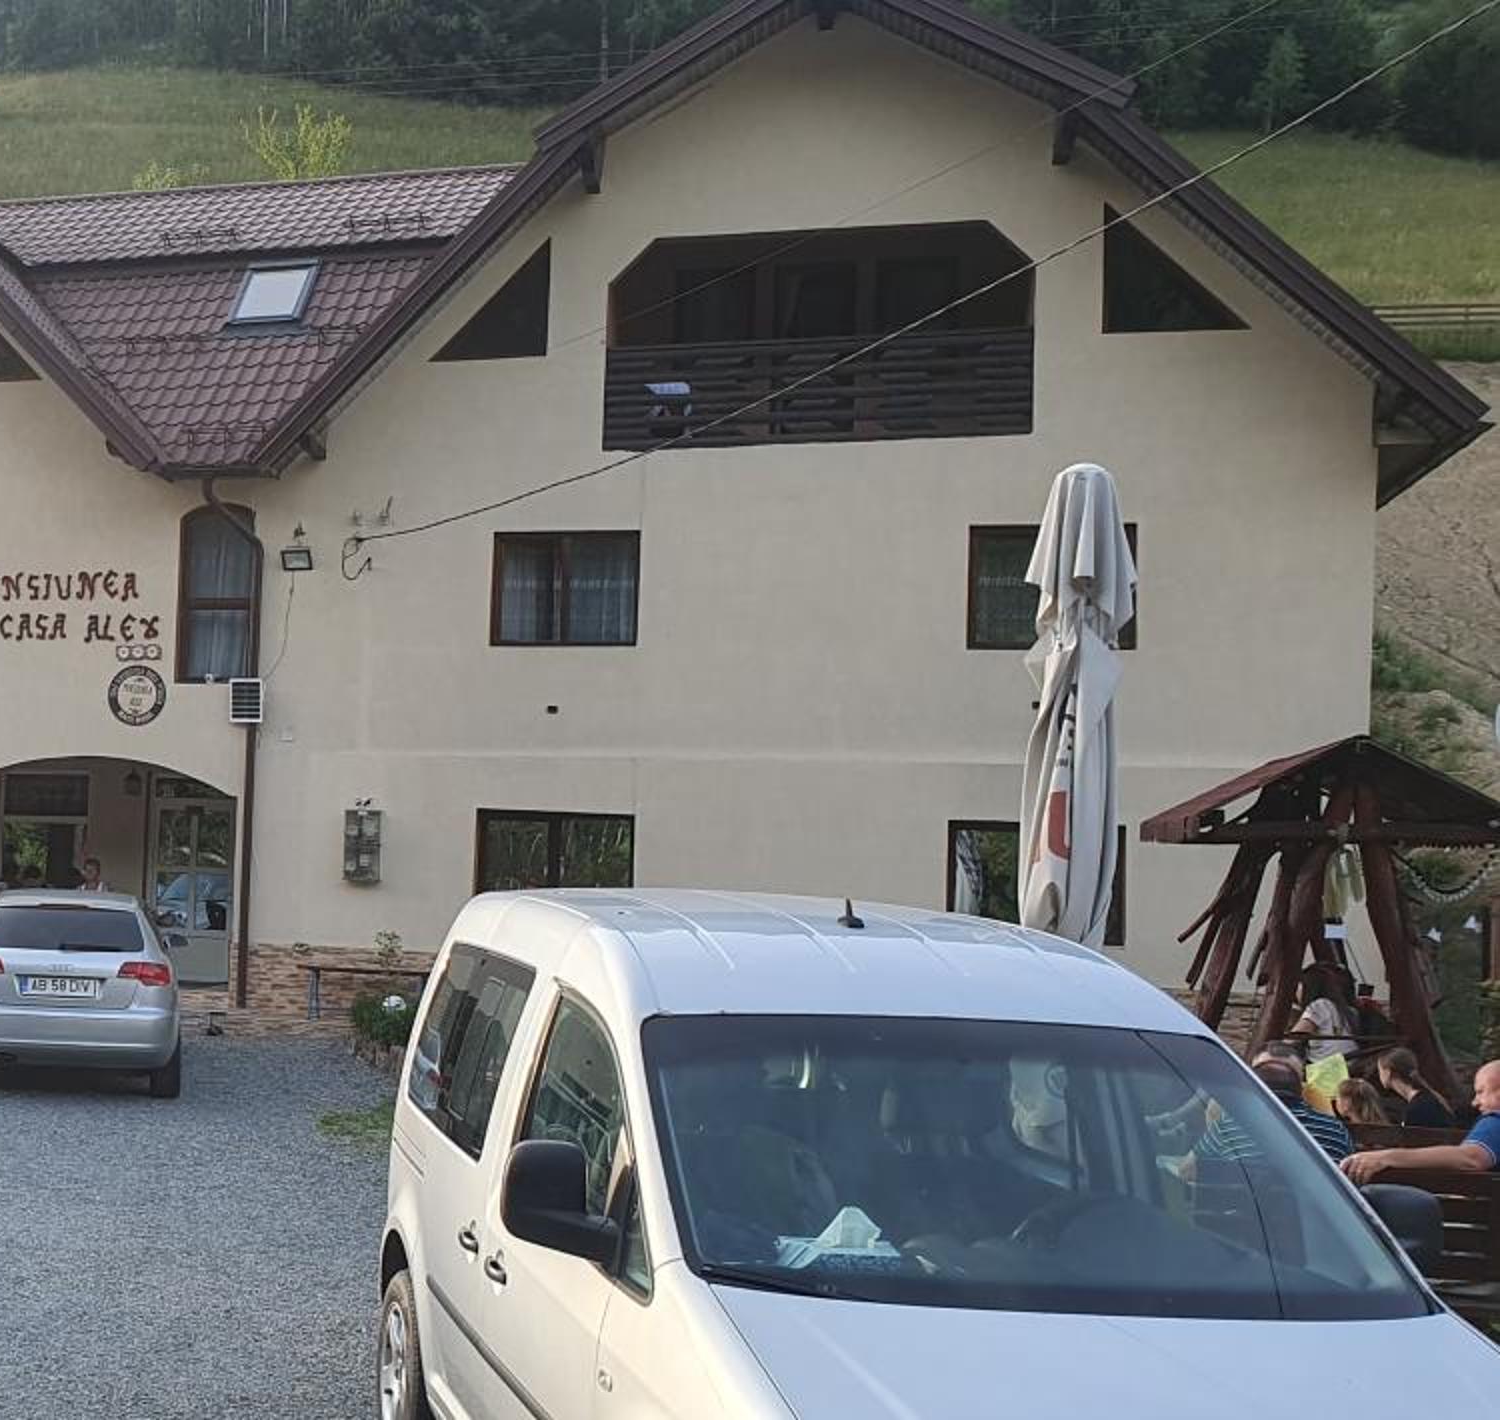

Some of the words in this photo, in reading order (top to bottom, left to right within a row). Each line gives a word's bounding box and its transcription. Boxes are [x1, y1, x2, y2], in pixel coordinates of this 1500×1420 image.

[0, 613, 67, 641] CASA
[84, 613, 160, 643] ALEX
[32, 979, 47, 991] AB
[51, 980, 66, 992] 58
